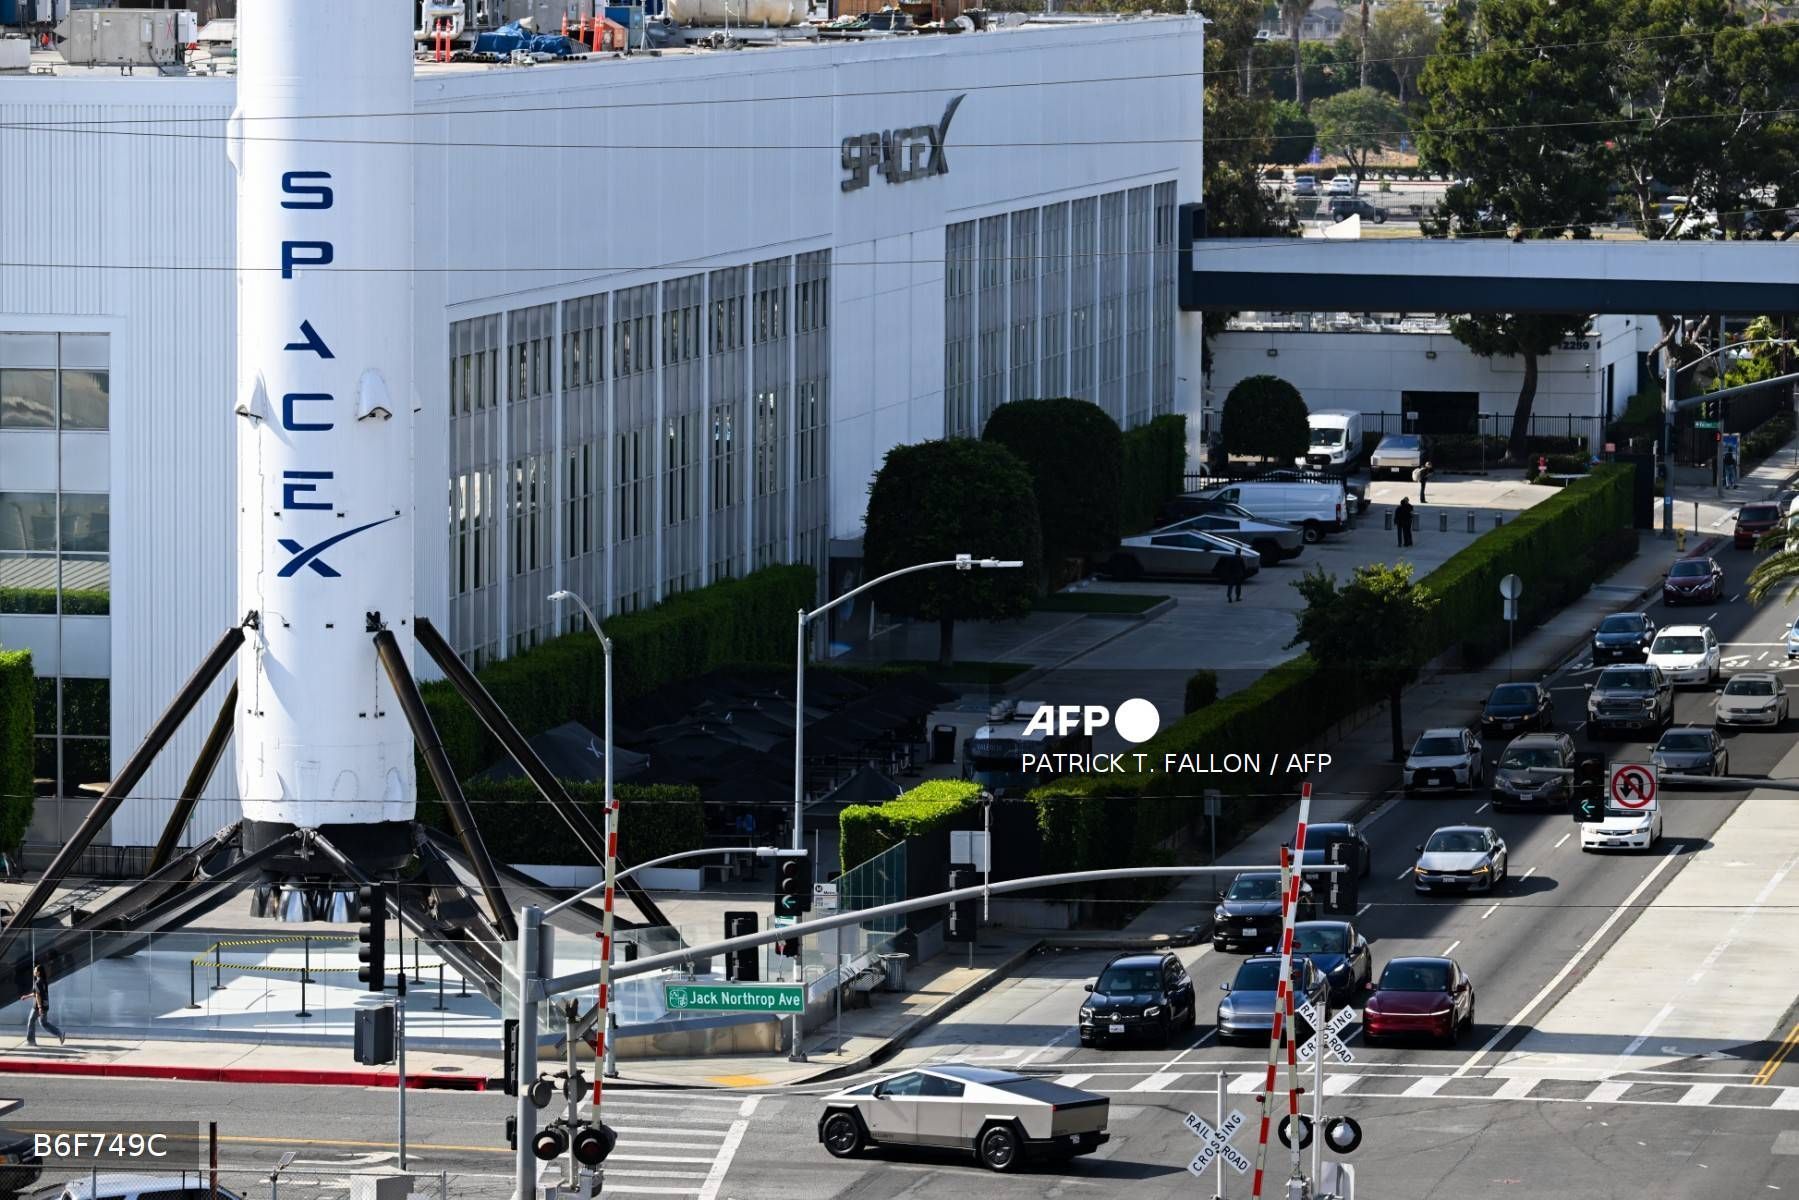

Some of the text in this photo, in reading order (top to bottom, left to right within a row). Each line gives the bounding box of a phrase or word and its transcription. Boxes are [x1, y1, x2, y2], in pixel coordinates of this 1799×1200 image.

[841, 93, 967, 192] SPACEX
[277, 171, 401, 577] SPACEX
[689, 991, 801, 1008] Jack Northrop Ave
[1300, 1004, 1352, 1063] RAI ROAD
[1186, 1114, 1248, 1171] RAIL ROAD
[1192, 1114, 1241, 1172] CROSSING
